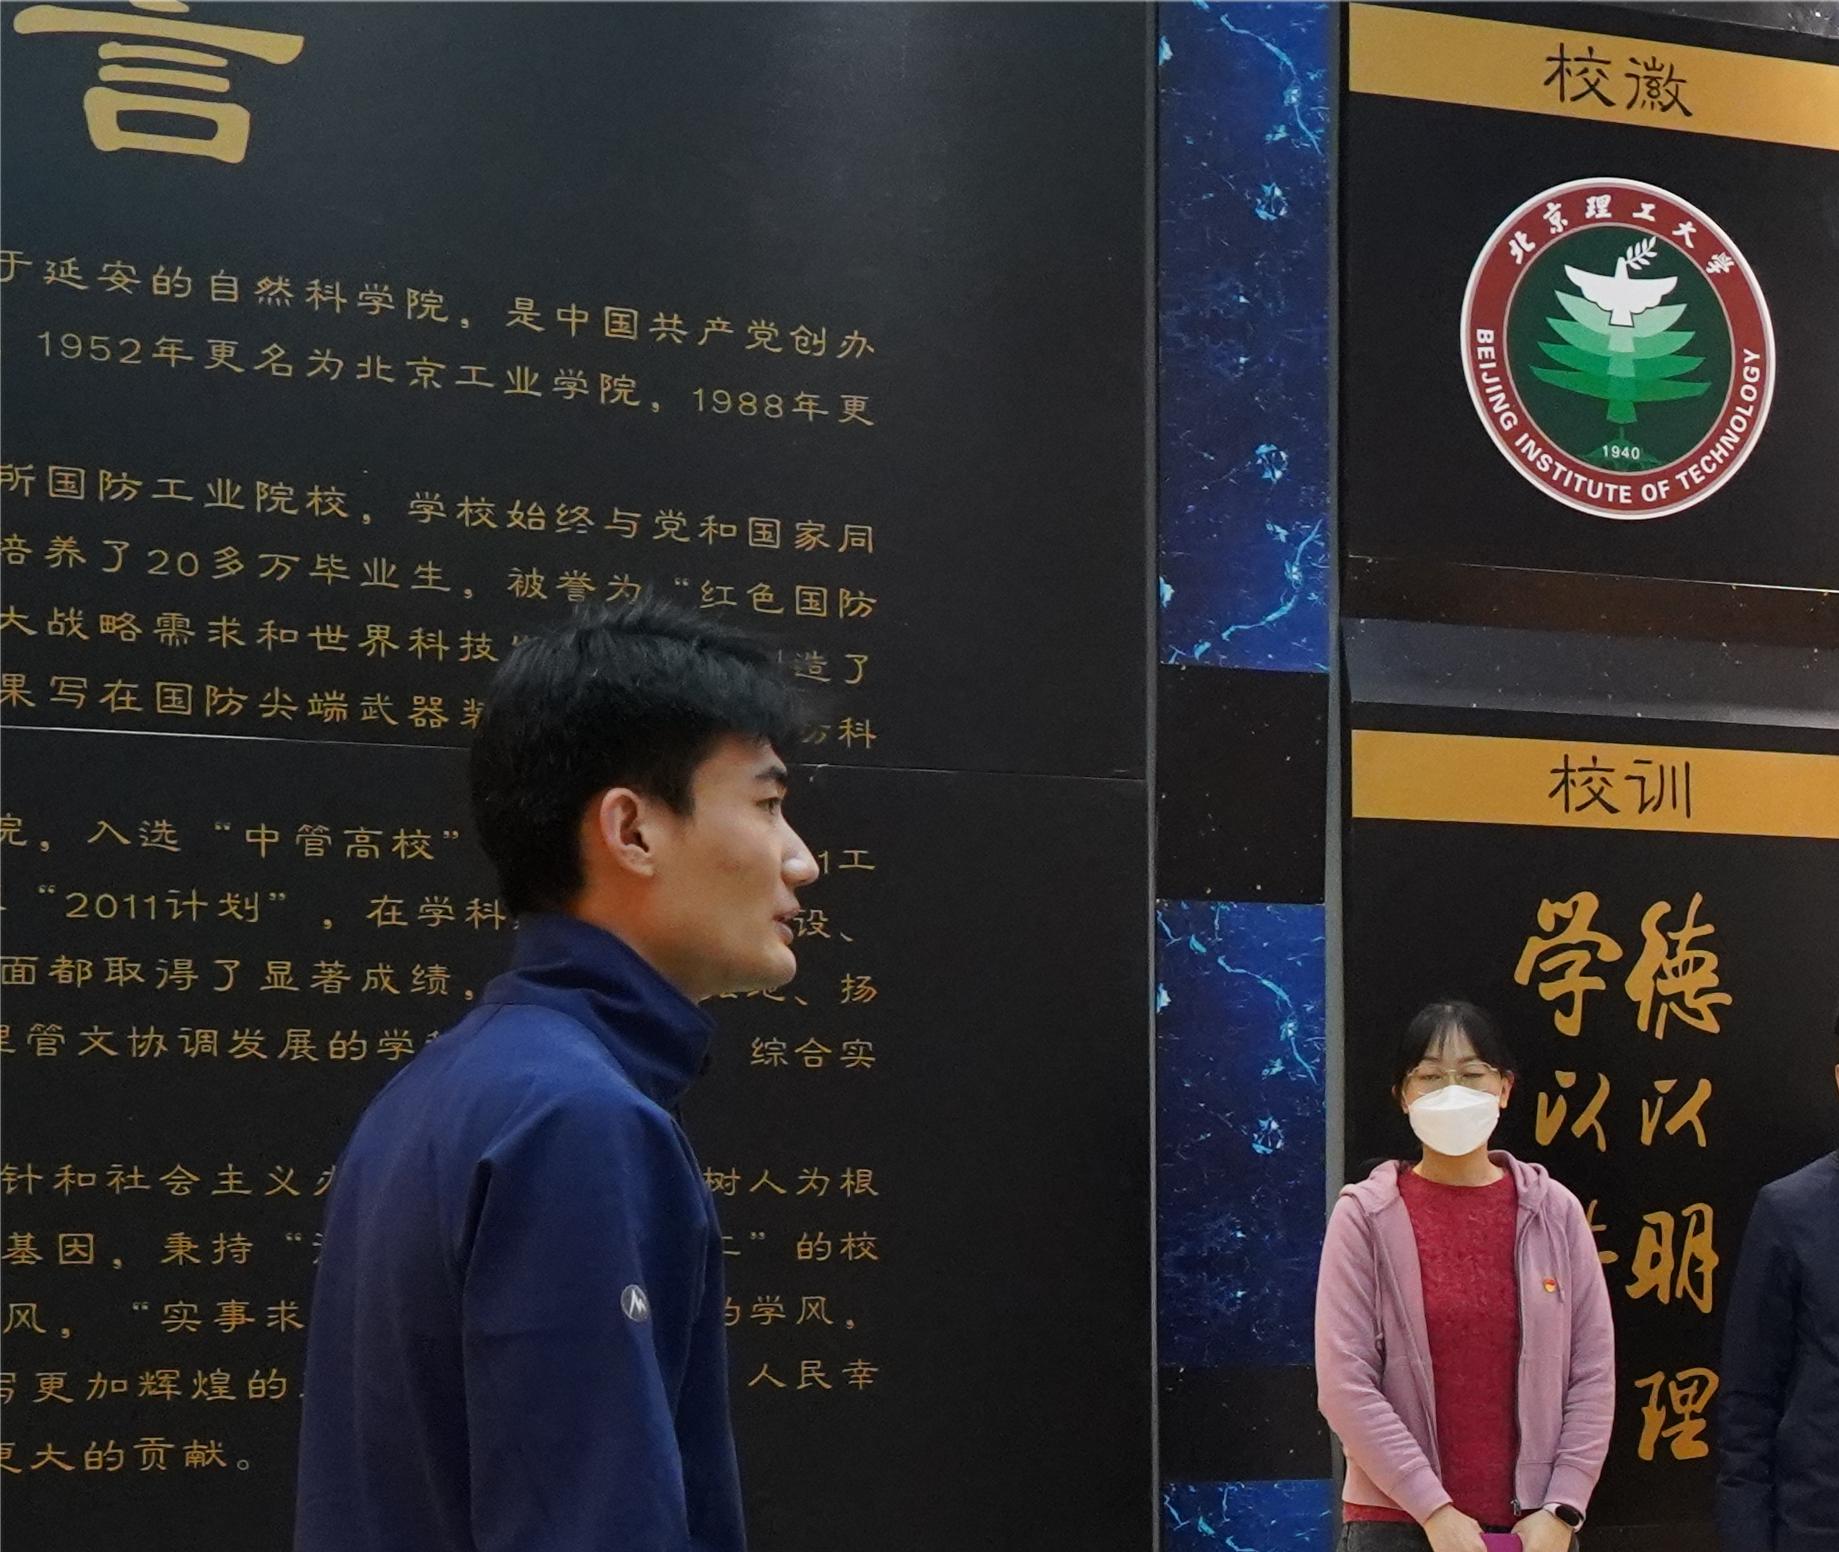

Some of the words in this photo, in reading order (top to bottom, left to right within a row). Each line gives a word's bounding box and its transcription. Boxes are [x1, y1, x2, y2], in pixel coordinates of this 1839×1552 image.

[14, 0, 305, 164] 言
[1543, 41, 1694, 119] 校徽
[1475, 327, 1519, 431] BEIJING
[1514, 431, 1632, 504] INSTITUTE
[1640, 482, 1671, 502] OF
[1674, 348, 1762, 490] TECHNOLOGY
[1602, 444, 1641, 461] 1940
[0, 605, 529, 662] 大战略需求和世界科技
[1546, 753, 1692, 819] 校训
[0, 1022, 442, 1064] 管文协调发展的学
[750, 1036, 876, 1070] 综合实
[704, 1166, 879, 1197] 树人为根
[2, 1231, 326, 1271] 基因，秉持“
[748, 1358, 879, 1390] 人民幸
